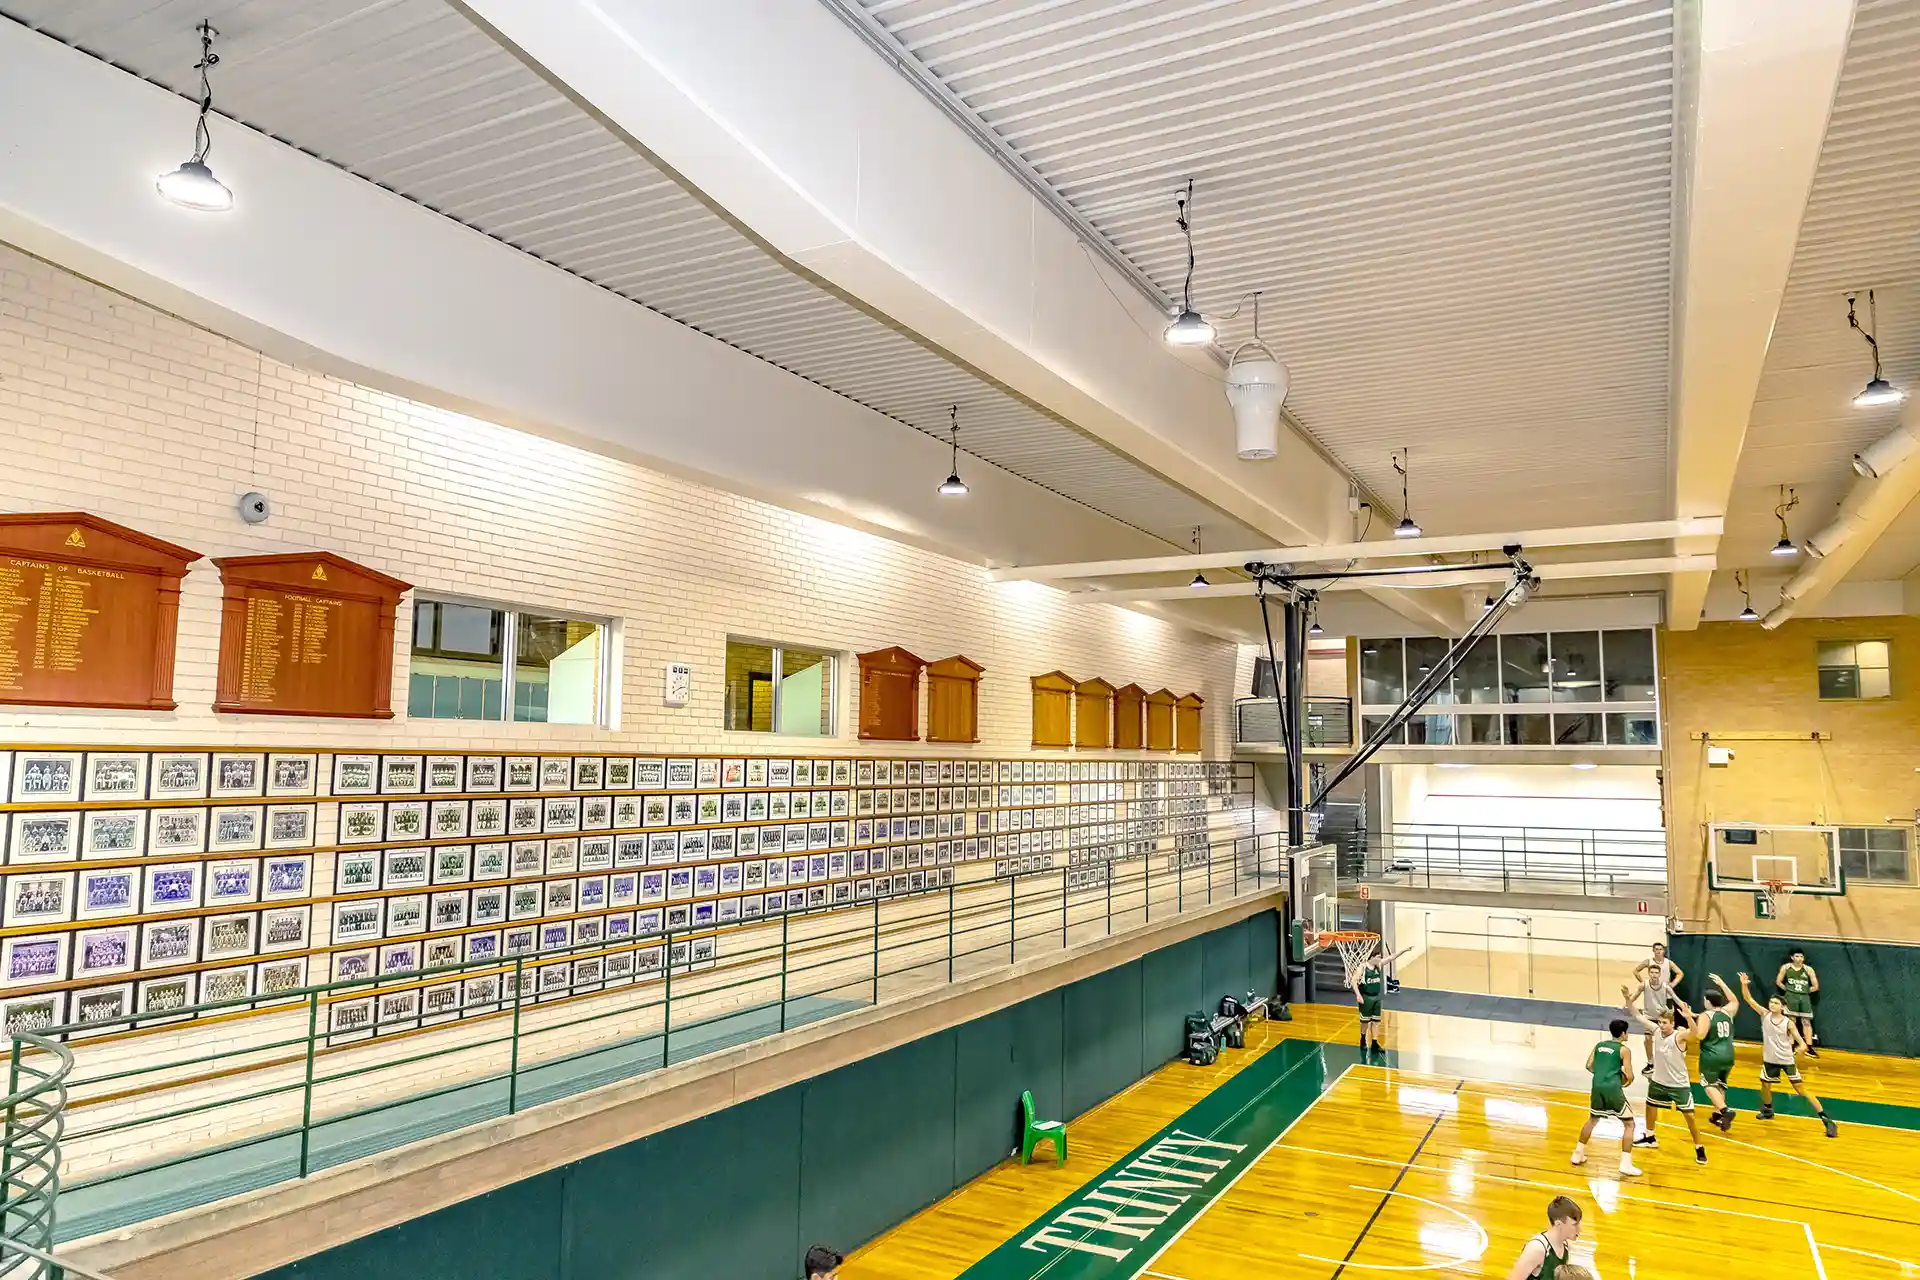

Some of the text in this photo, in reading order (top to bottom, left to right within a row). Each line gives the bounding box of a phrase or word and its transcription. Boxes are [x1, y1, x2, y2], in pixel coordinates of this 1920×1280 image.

[10, 559, 50, 570] CAPTAINS
[77, 568, 125, 579] BASKETBALL
[284, 594, 344, 607] FOOTBALL CAPTAINS
[1760, 901, 1770, 915] 1
[1716, 1020, 1730, 1038] 99
[1019, 1128, 1249, 1263] TRINITY
